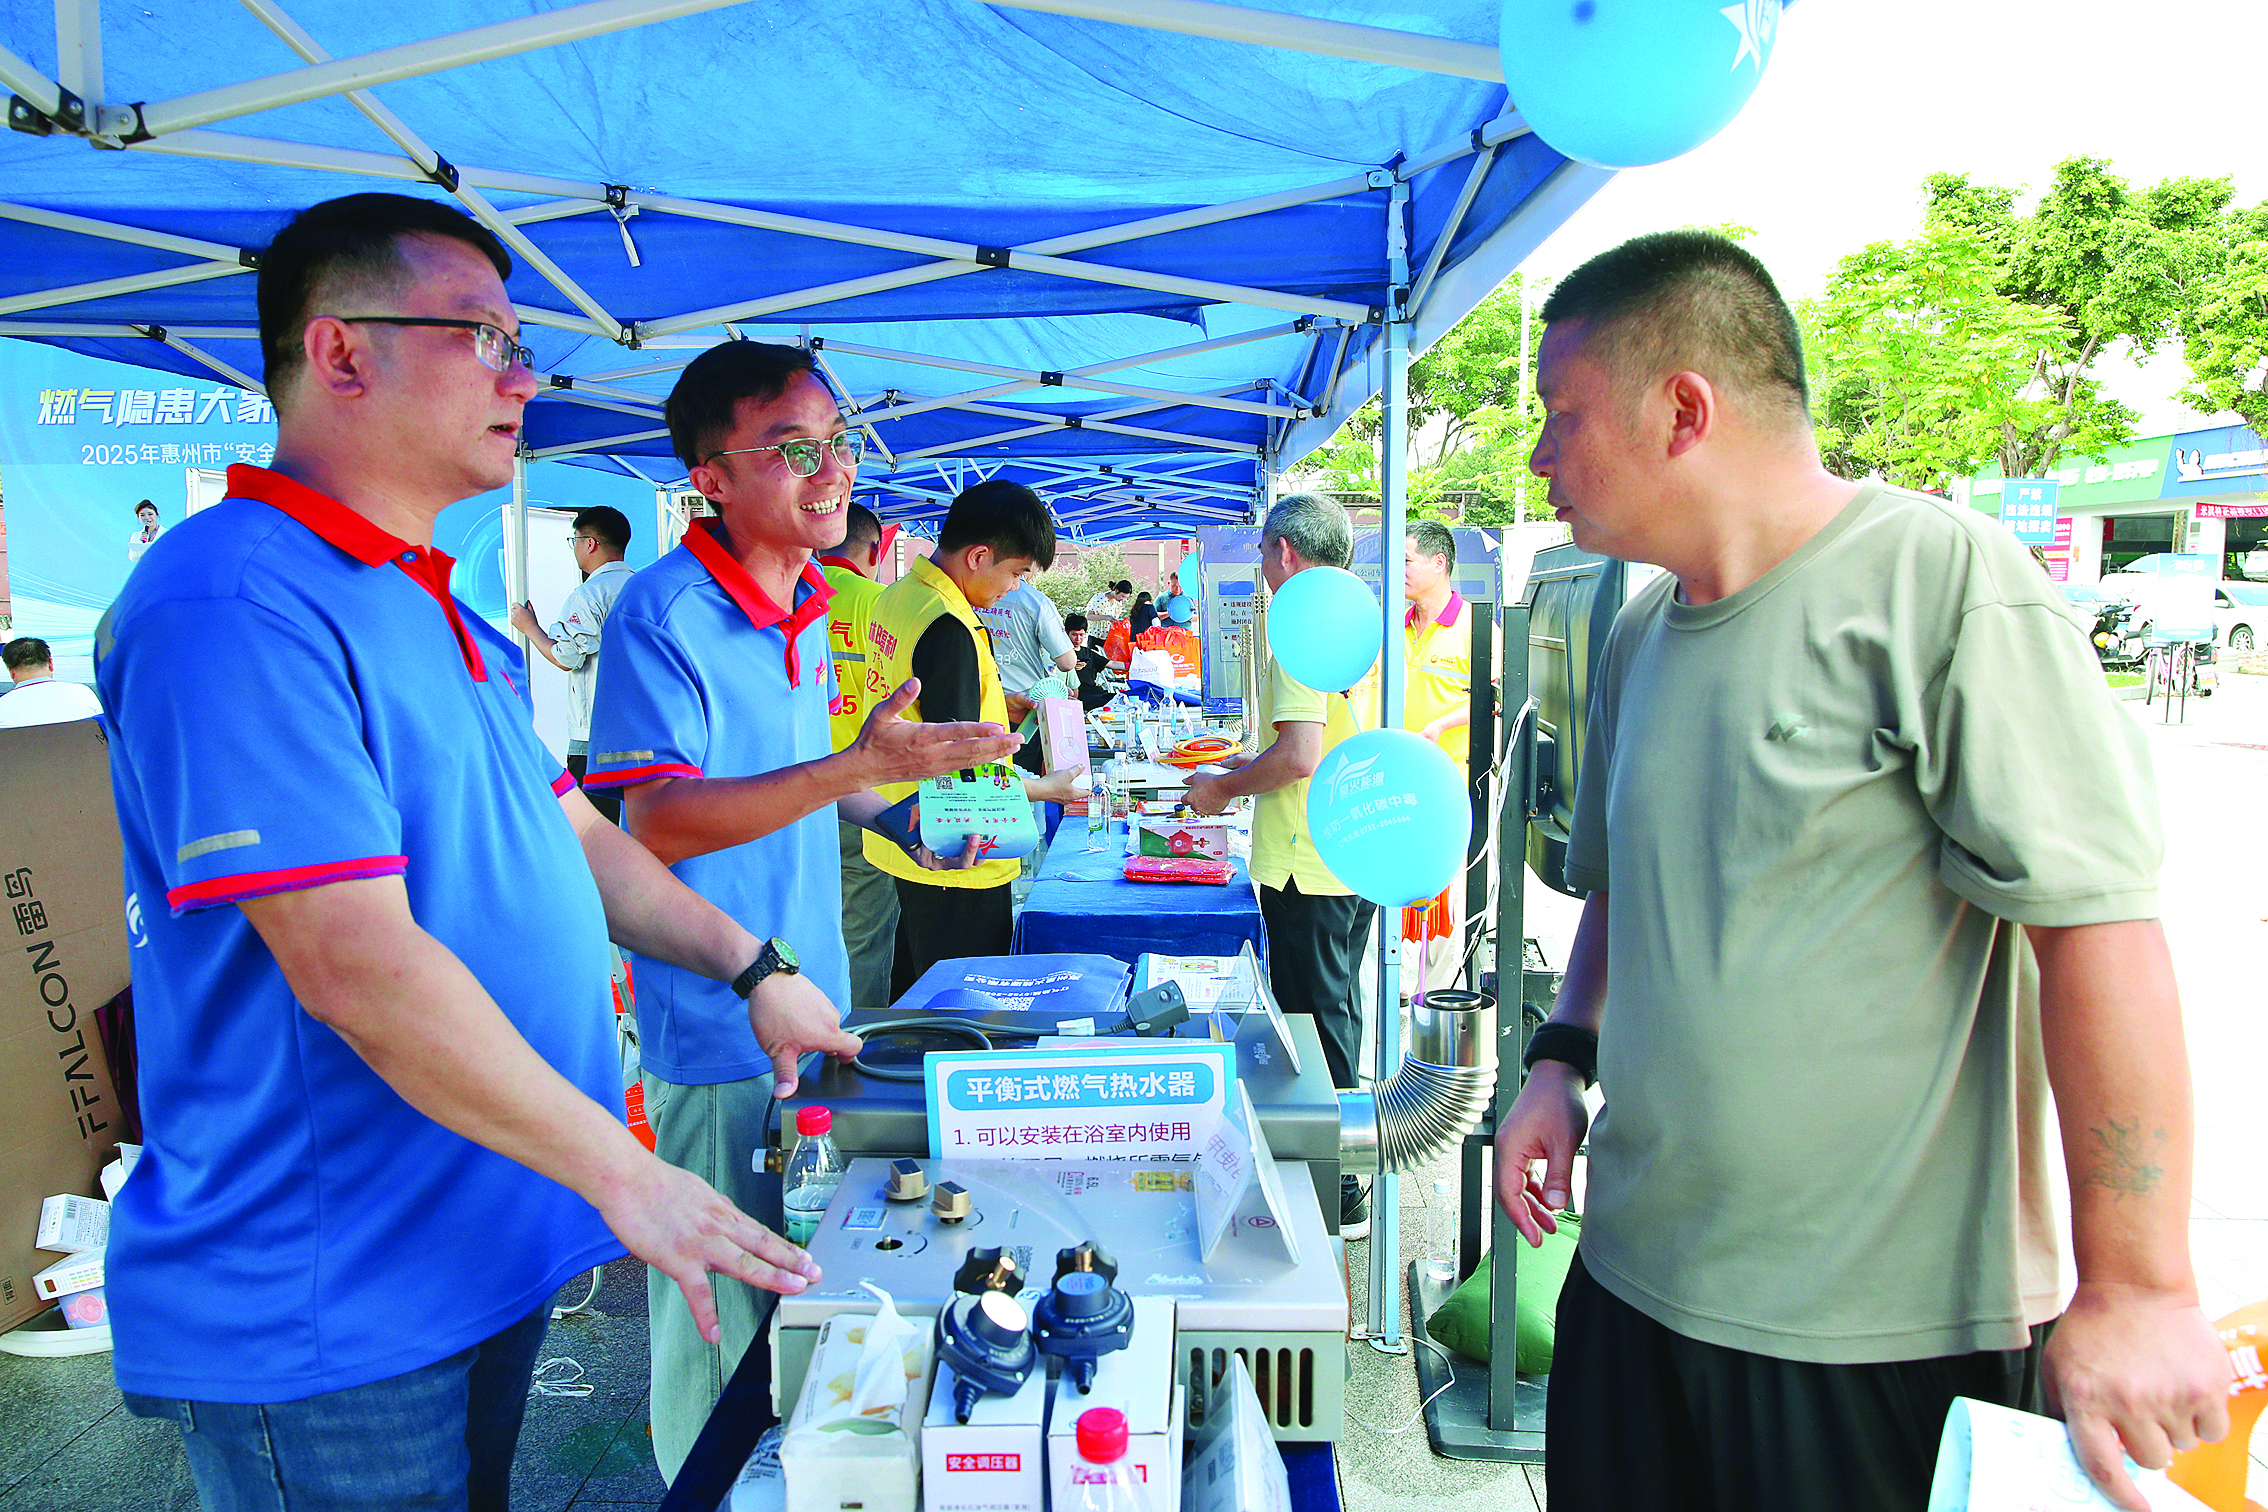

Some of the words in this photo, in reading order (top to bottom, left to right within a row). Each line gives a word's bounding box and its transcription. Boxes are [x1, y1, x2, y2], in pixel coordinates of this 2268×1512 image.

[38, 387, 278, 428] 燃气隐患大家
[4, 867, 49, 936] 雷鸟
[26, 940, 108, 1140] FFALCON
[966, 1071, 1196, 1103] 平衡式燃气热水器
[976, 1122, 1191, 1147] 可以安装在浴室内使用
[948, 1456, 1019, 1471] 安全调压器
